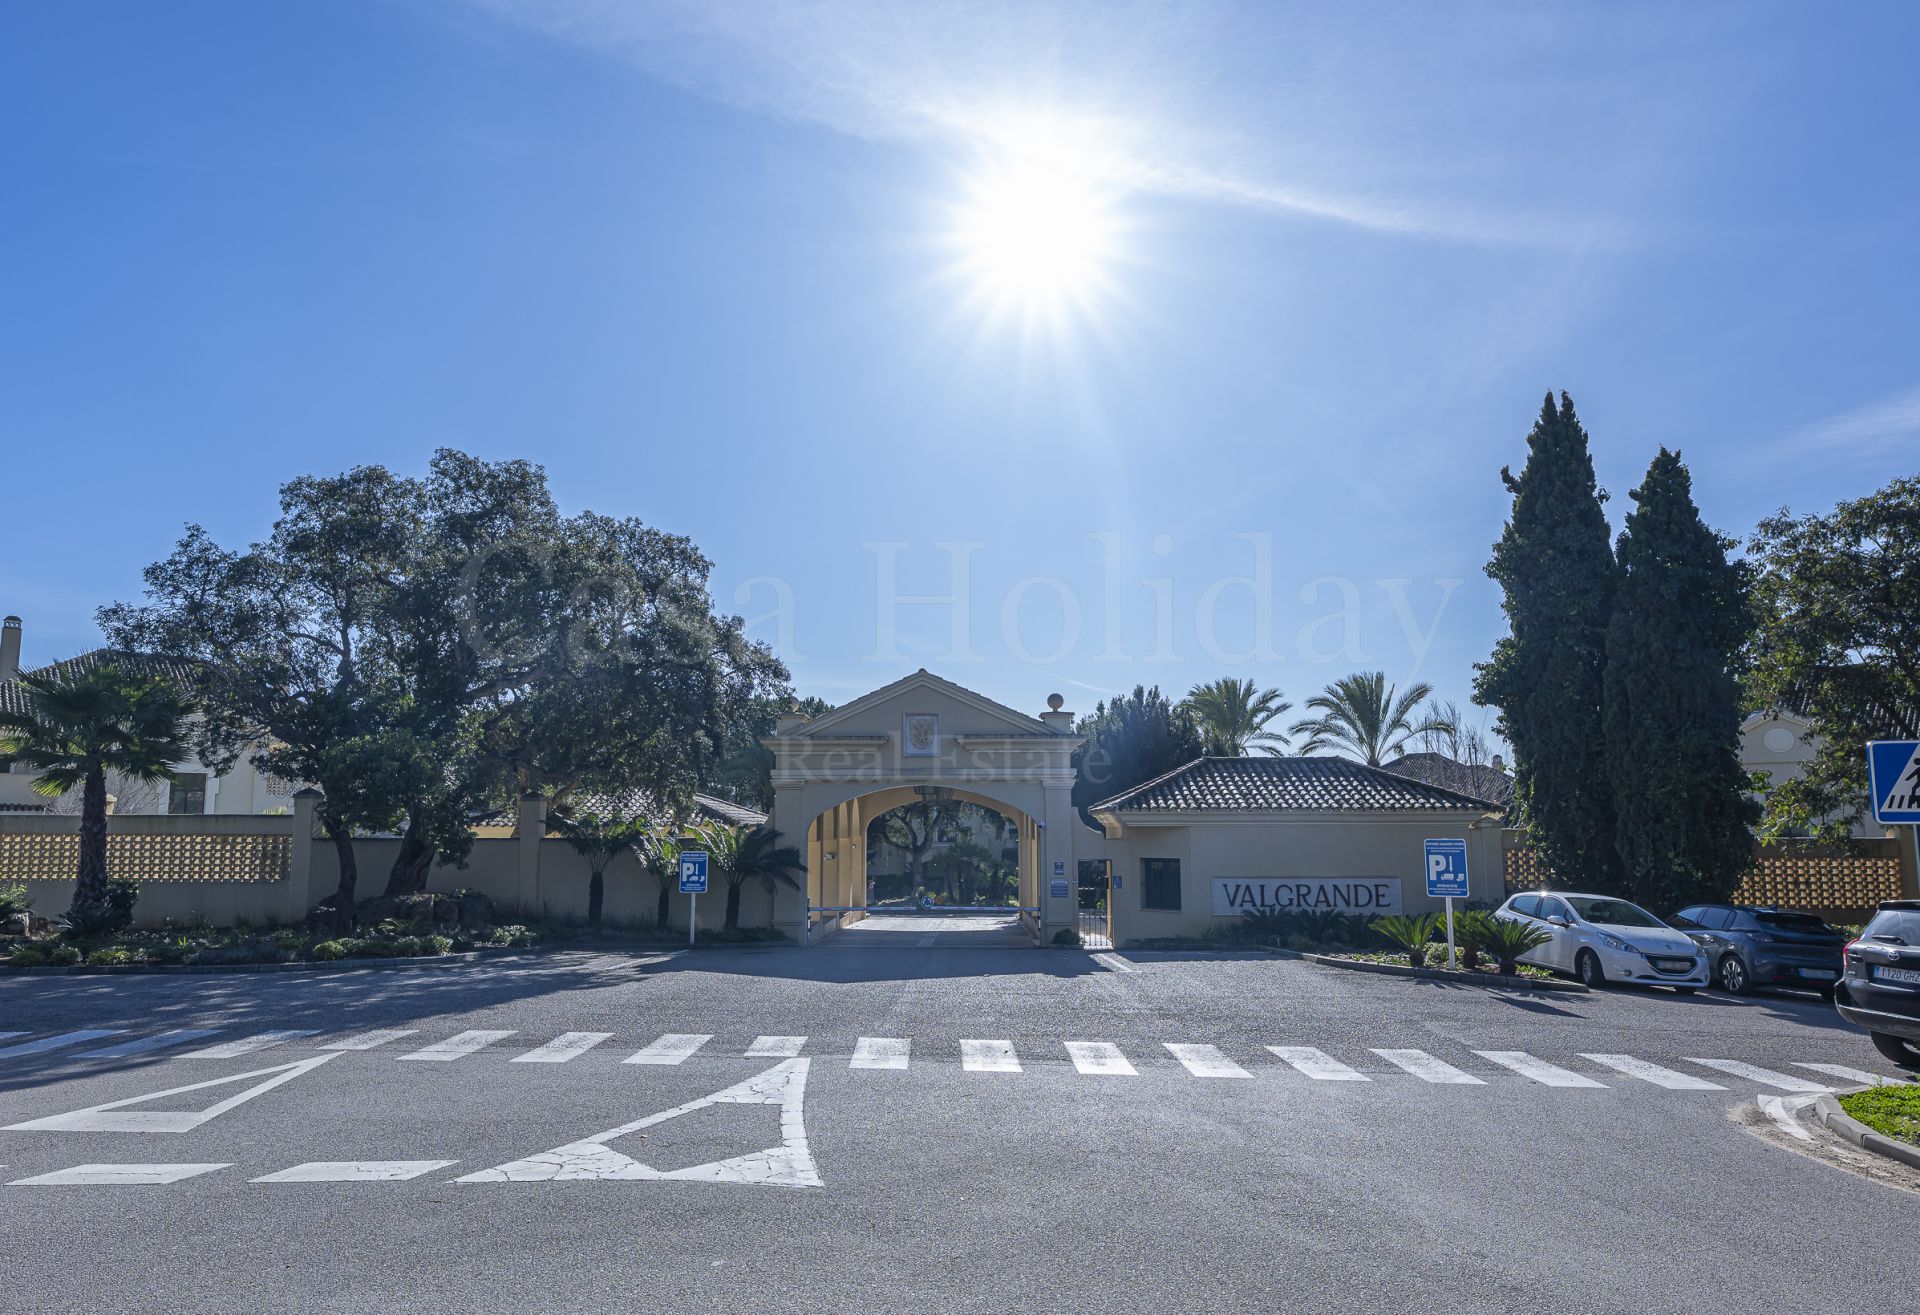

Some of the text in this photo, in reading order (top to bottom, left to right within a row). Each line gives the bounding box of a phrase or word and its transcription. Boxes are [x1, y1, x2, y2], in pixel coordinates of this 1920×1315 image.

[682, 862, 694, 881] P
[1429, 855, 1446, 880] P
[1222, 883, 1391, 907] VALGRANDE
